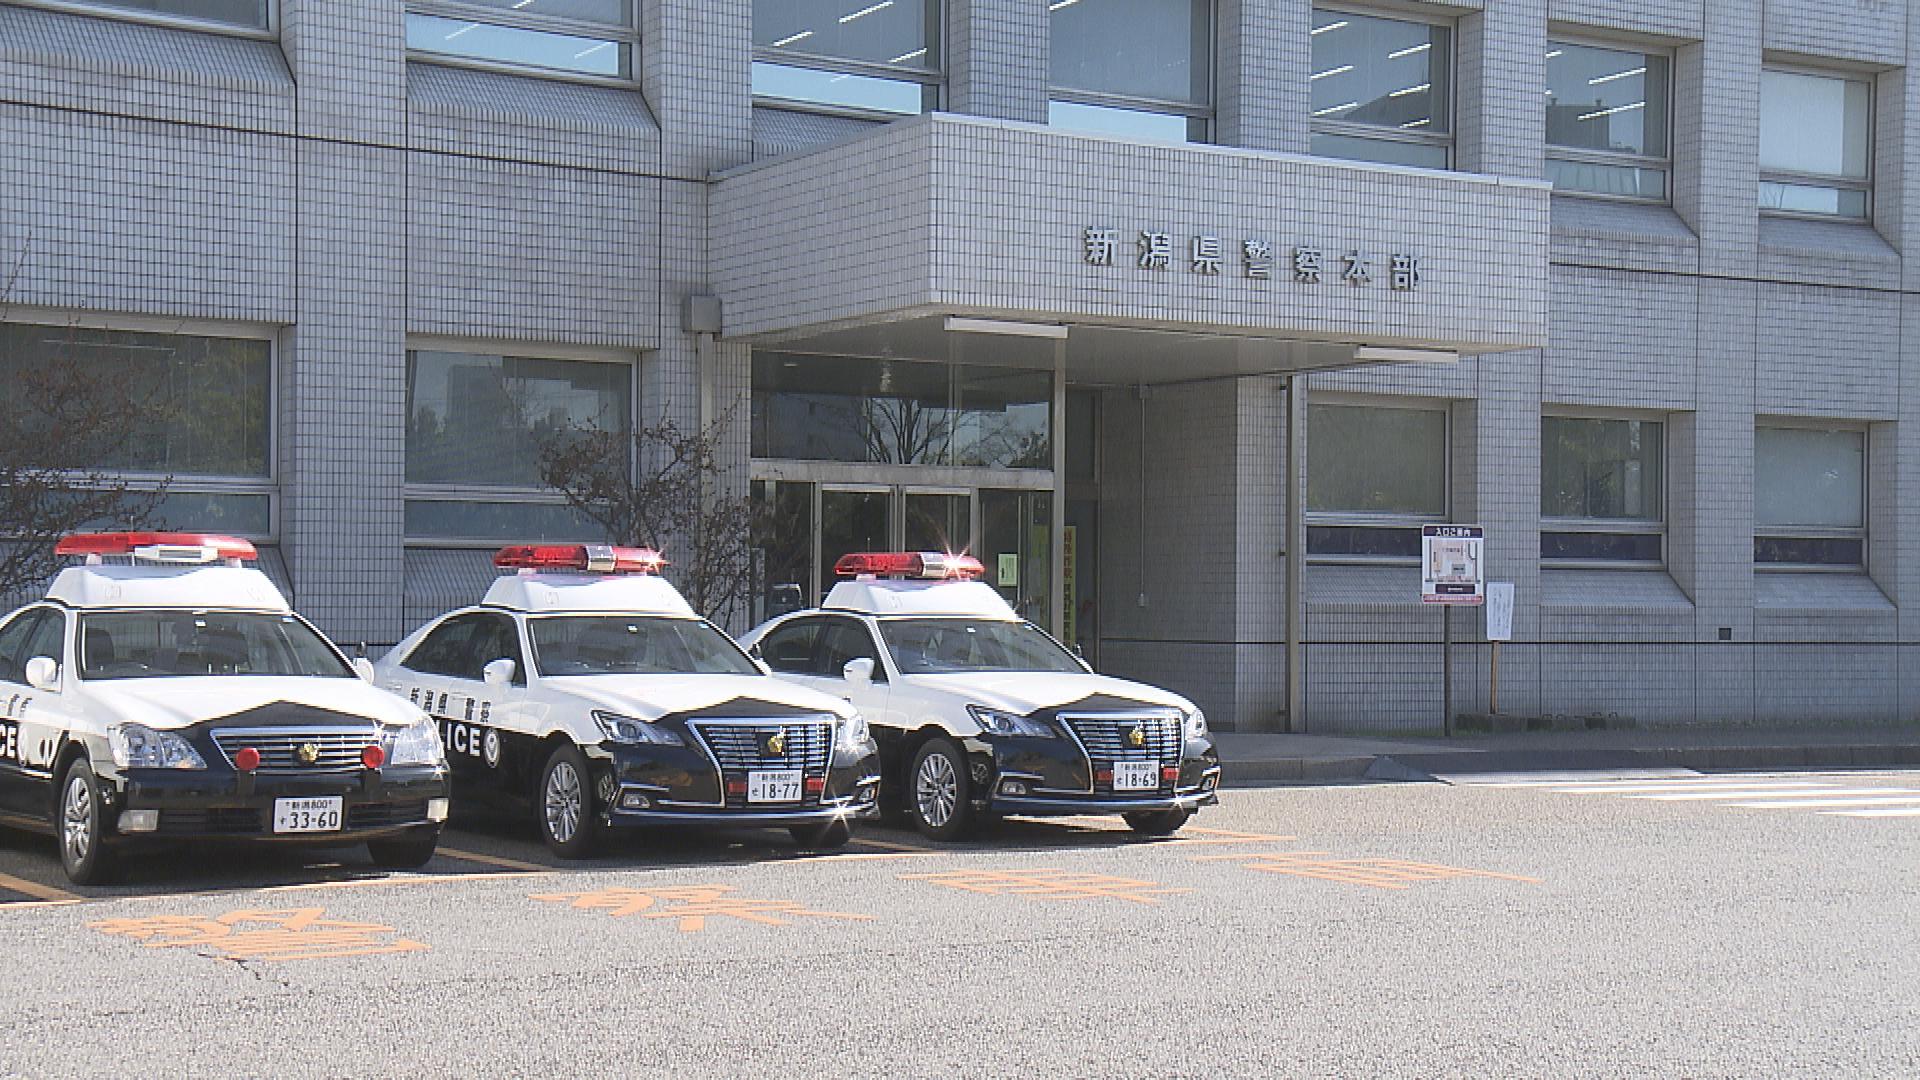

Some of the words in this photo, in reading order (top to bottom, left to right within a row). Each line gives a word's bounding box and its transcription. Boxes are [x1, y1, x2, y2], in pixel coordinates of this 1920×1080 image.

[1083, 225, 1420, 291] 新潟県警察本部
[761, 783, 799, 799] 18-77
[289, 811, 338, 829] 33-60
